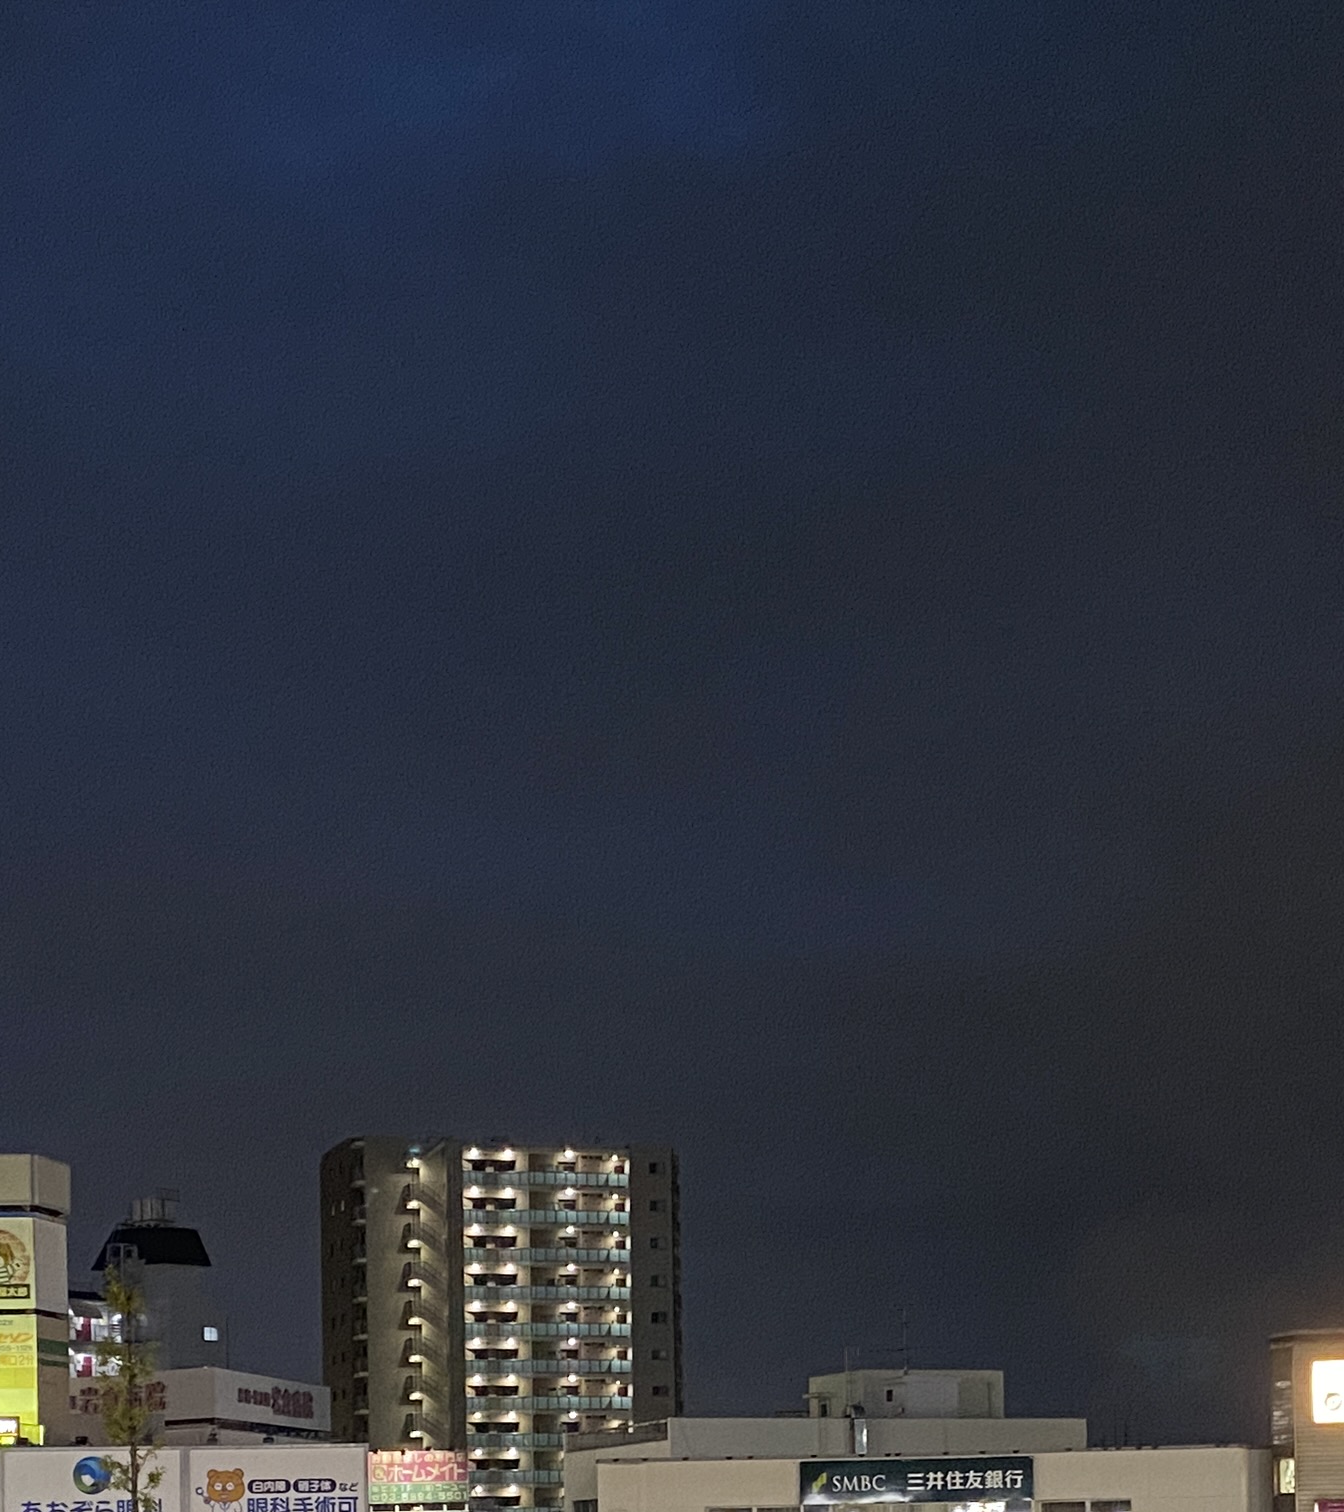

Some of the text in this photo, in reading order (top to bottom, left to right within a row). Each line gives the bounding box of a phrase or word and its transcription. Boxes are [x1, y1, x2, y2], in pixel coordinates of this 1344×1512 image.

[388, 1464, 466, 1481] ホームメイト
[832, 1470, 1023, 1492] SMBC 三井住友銀行
[252, 1481, 286, 1492] 白内障
[339, 1482, 358, 1492] など
